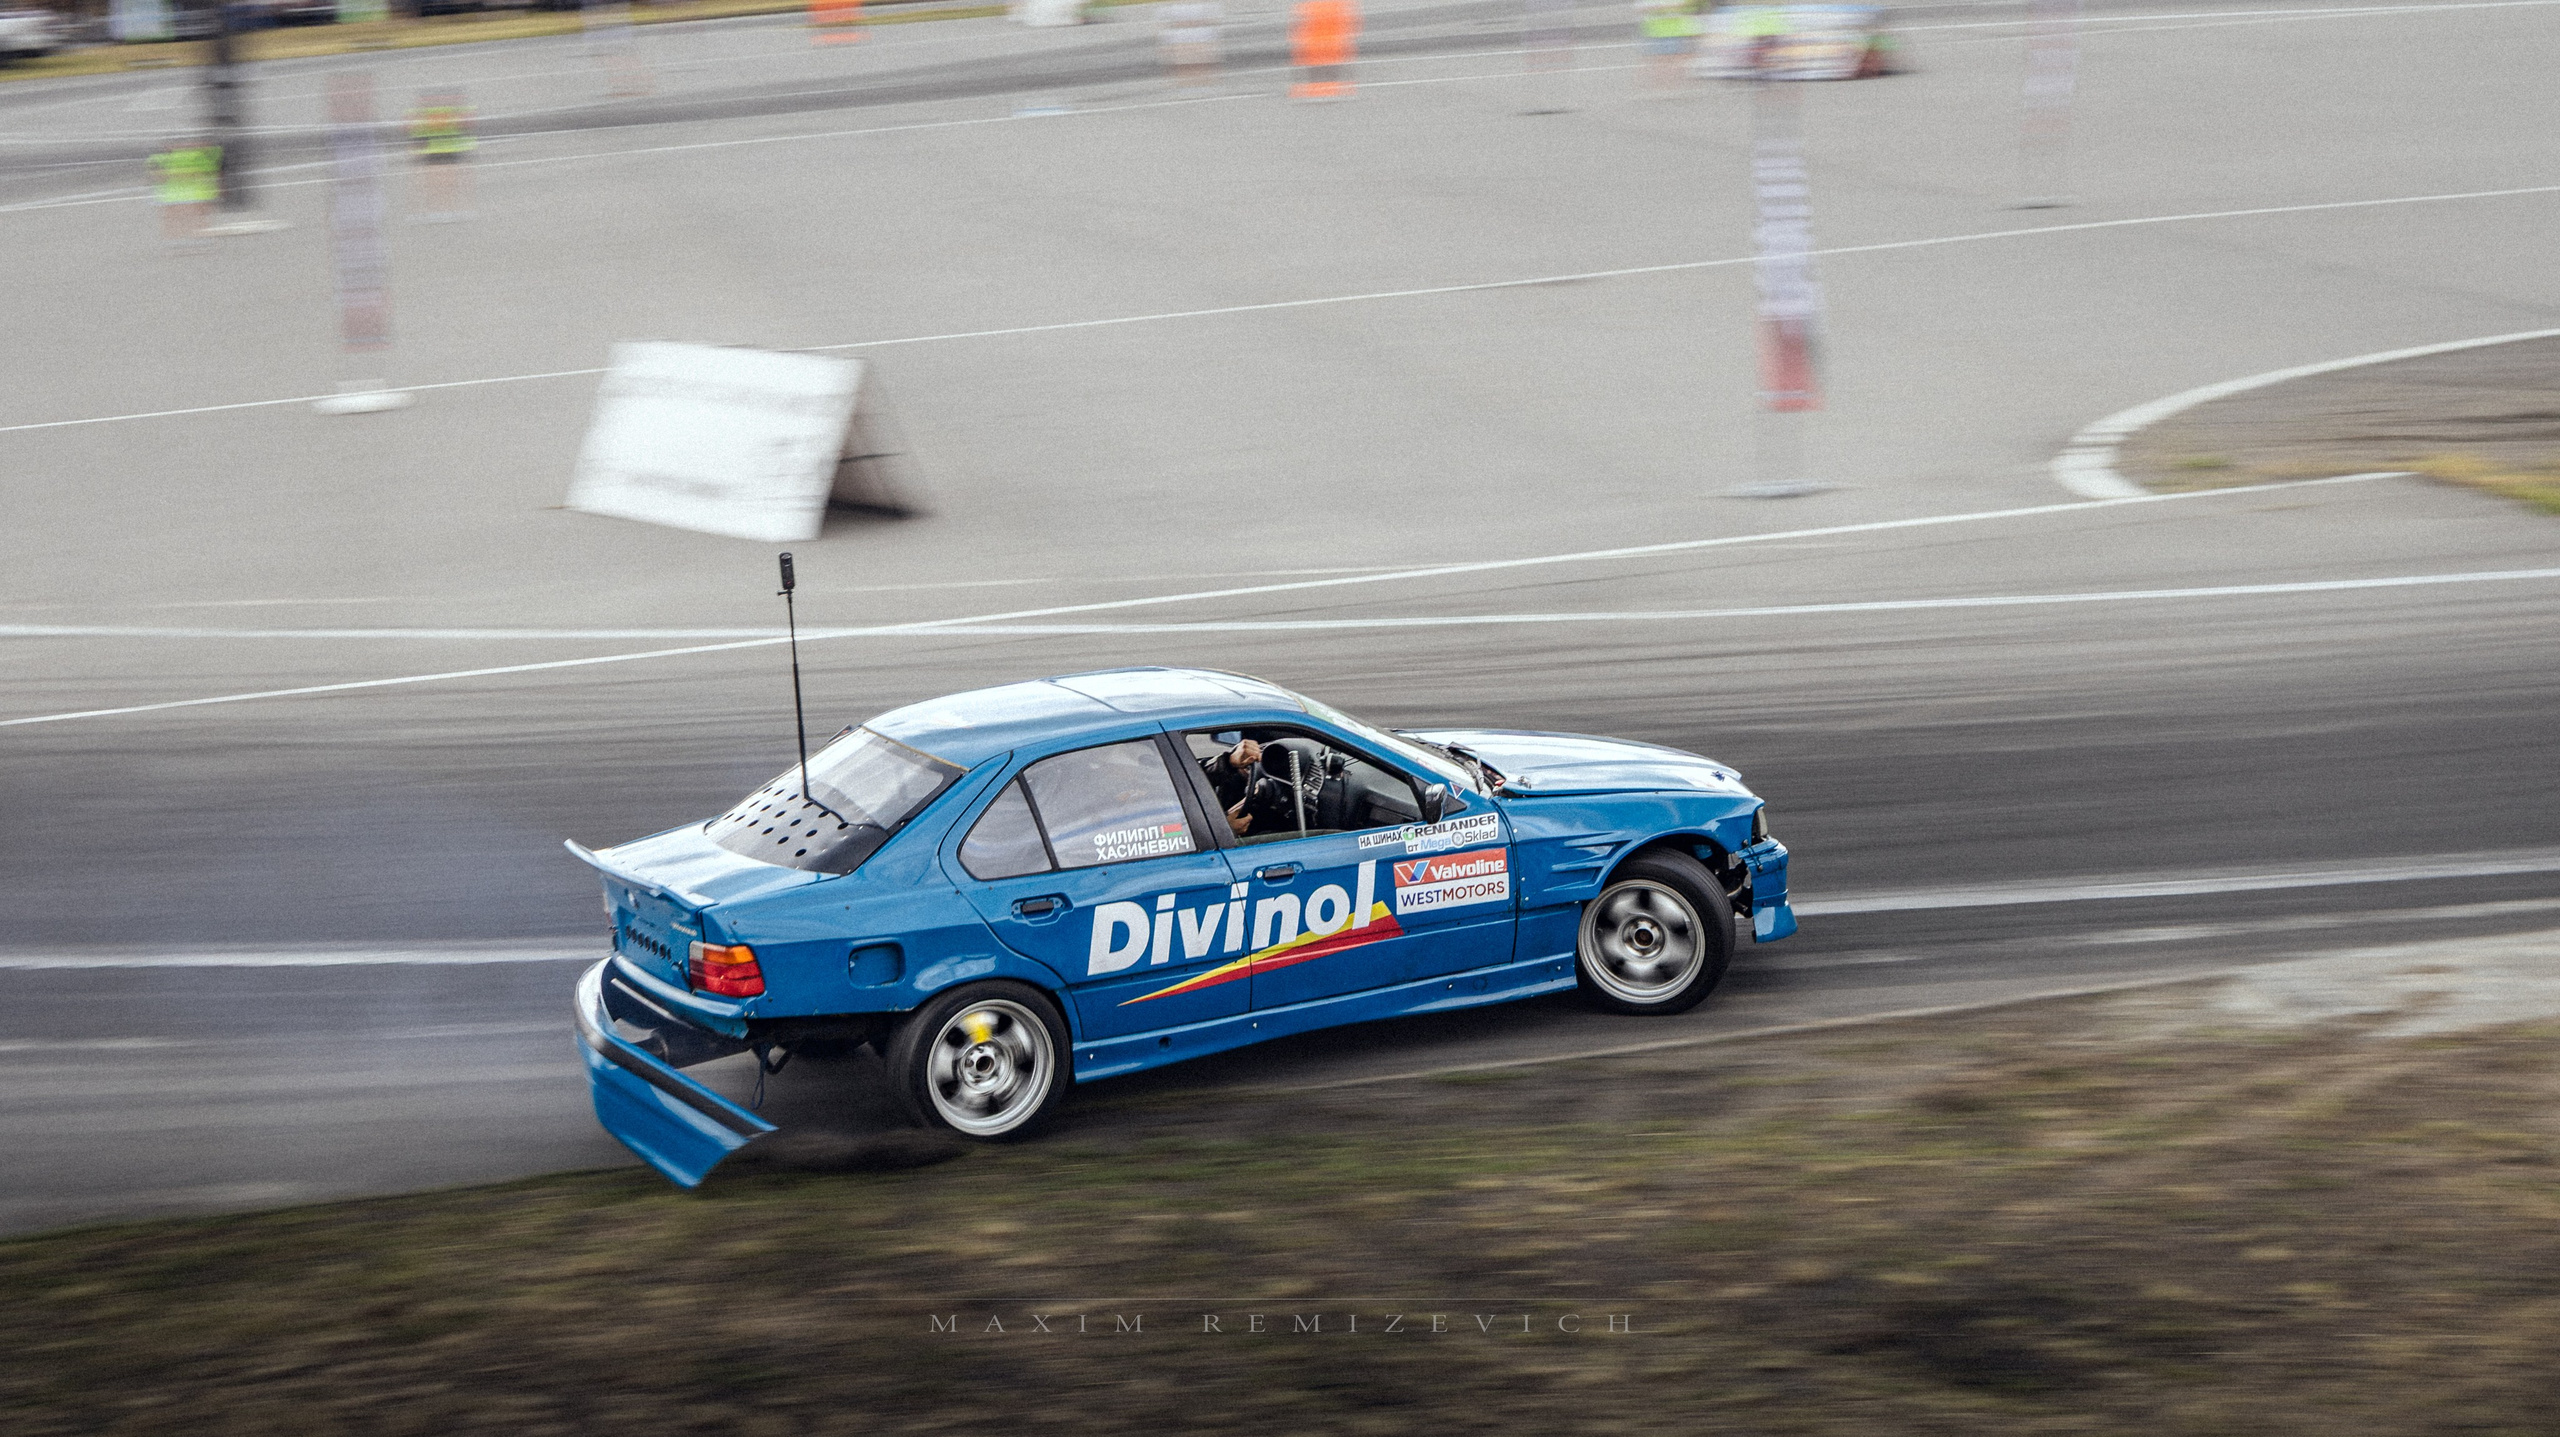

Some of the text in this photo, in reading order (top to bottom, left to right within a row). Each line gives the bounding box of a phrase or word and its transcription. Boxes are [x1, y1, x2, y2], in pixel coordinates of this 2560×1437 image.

[1093, 826, 1160, 847] ФИЛИПП
[1360, 815, 1497, 848] НА ШИНАХ GRENLANDER
[1096, 836, 1190, 861] ХАСИНЕВИЧ
[1430, 859, 1506, 881] Valvoline
[1401, 881, 1506, 908] WESTMOTORS
[1087, 859, 1377, 976] Divinol
